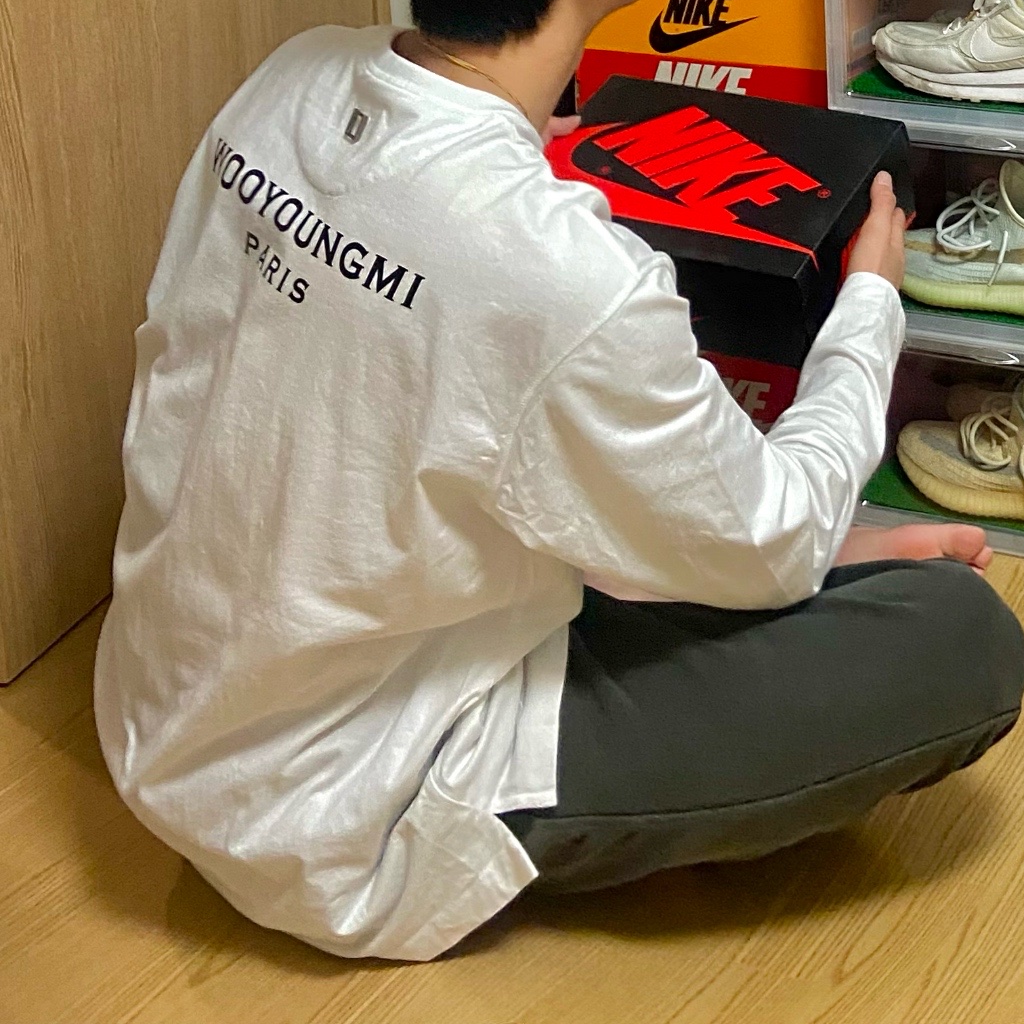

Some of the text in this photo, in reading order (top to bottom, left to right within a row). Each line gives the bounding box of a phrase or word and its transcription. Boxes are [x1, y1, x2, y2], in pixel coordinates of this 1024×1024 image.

[592, 105, 822, 220] NIKE
[211, 137, 426, 310] WOOYOUNGMI
[243, 230, 310, 304] PARIS
